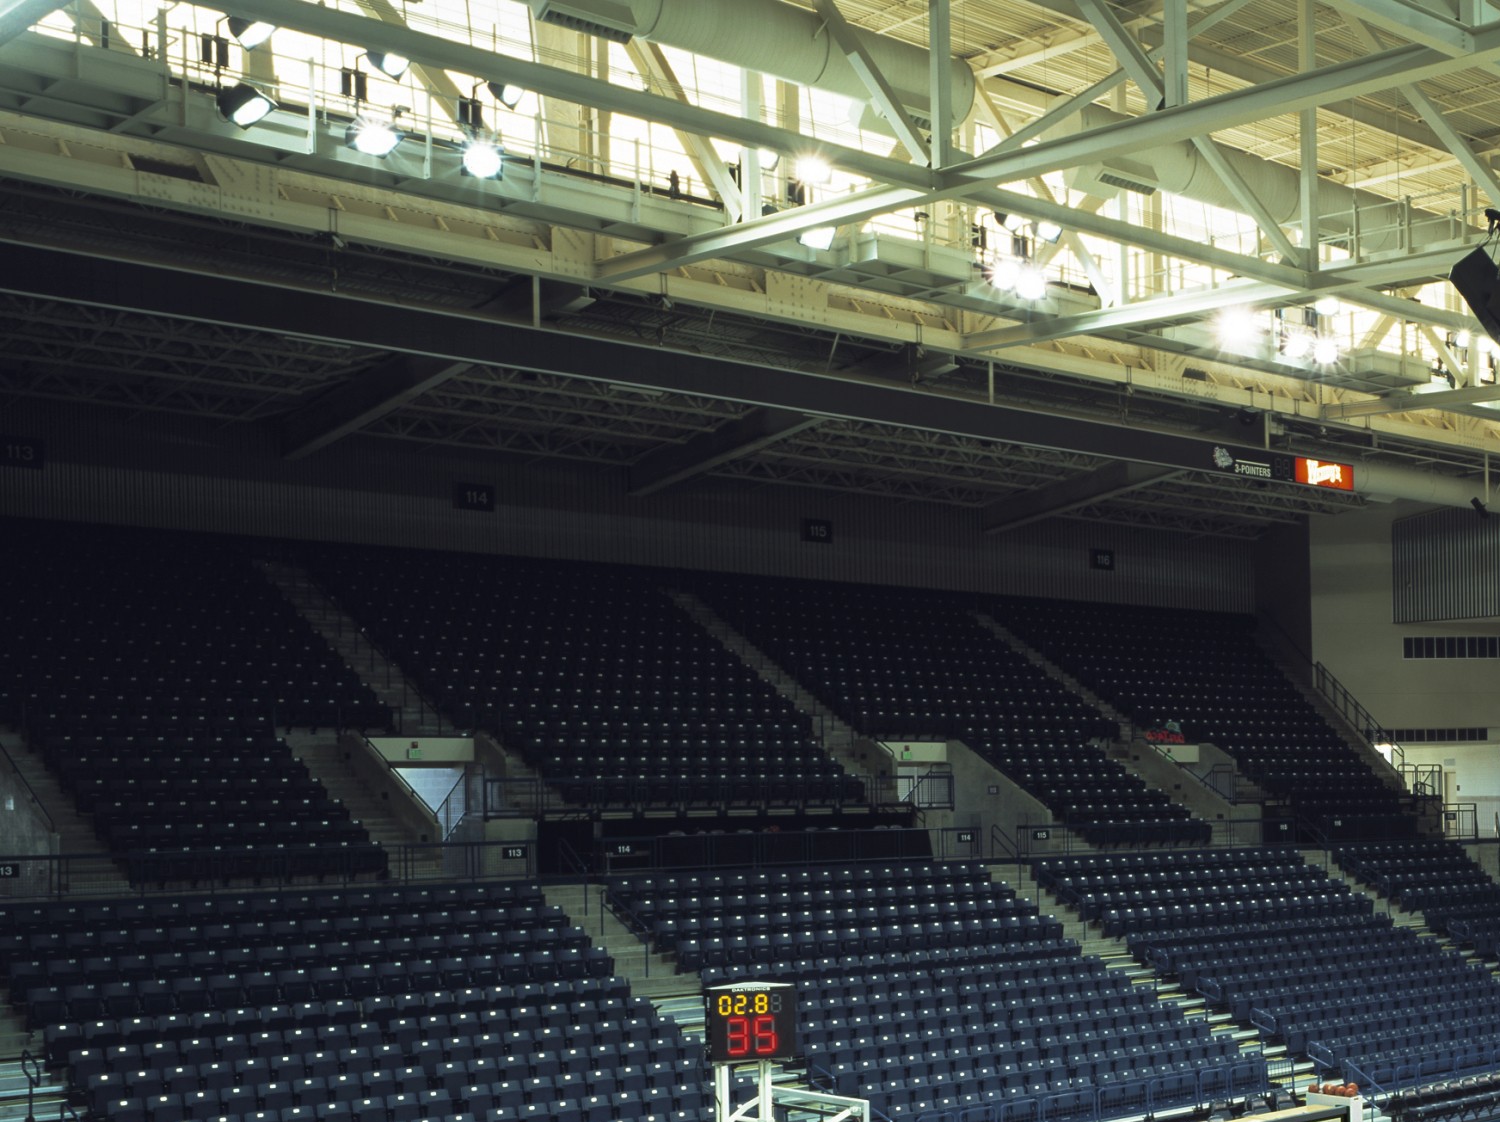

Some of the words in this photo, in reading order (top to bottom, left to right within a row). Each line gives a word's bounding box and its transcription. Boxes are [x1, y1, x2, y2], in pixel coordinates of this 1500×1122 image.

[1234, 463, 1271, 478] 3-POINTERS
[466, 490, 489, 505] 114
[508, 849, 522, 858] 113
[618, 845, 631, 853] 114
[727, 1017, 778, 1055] 35
